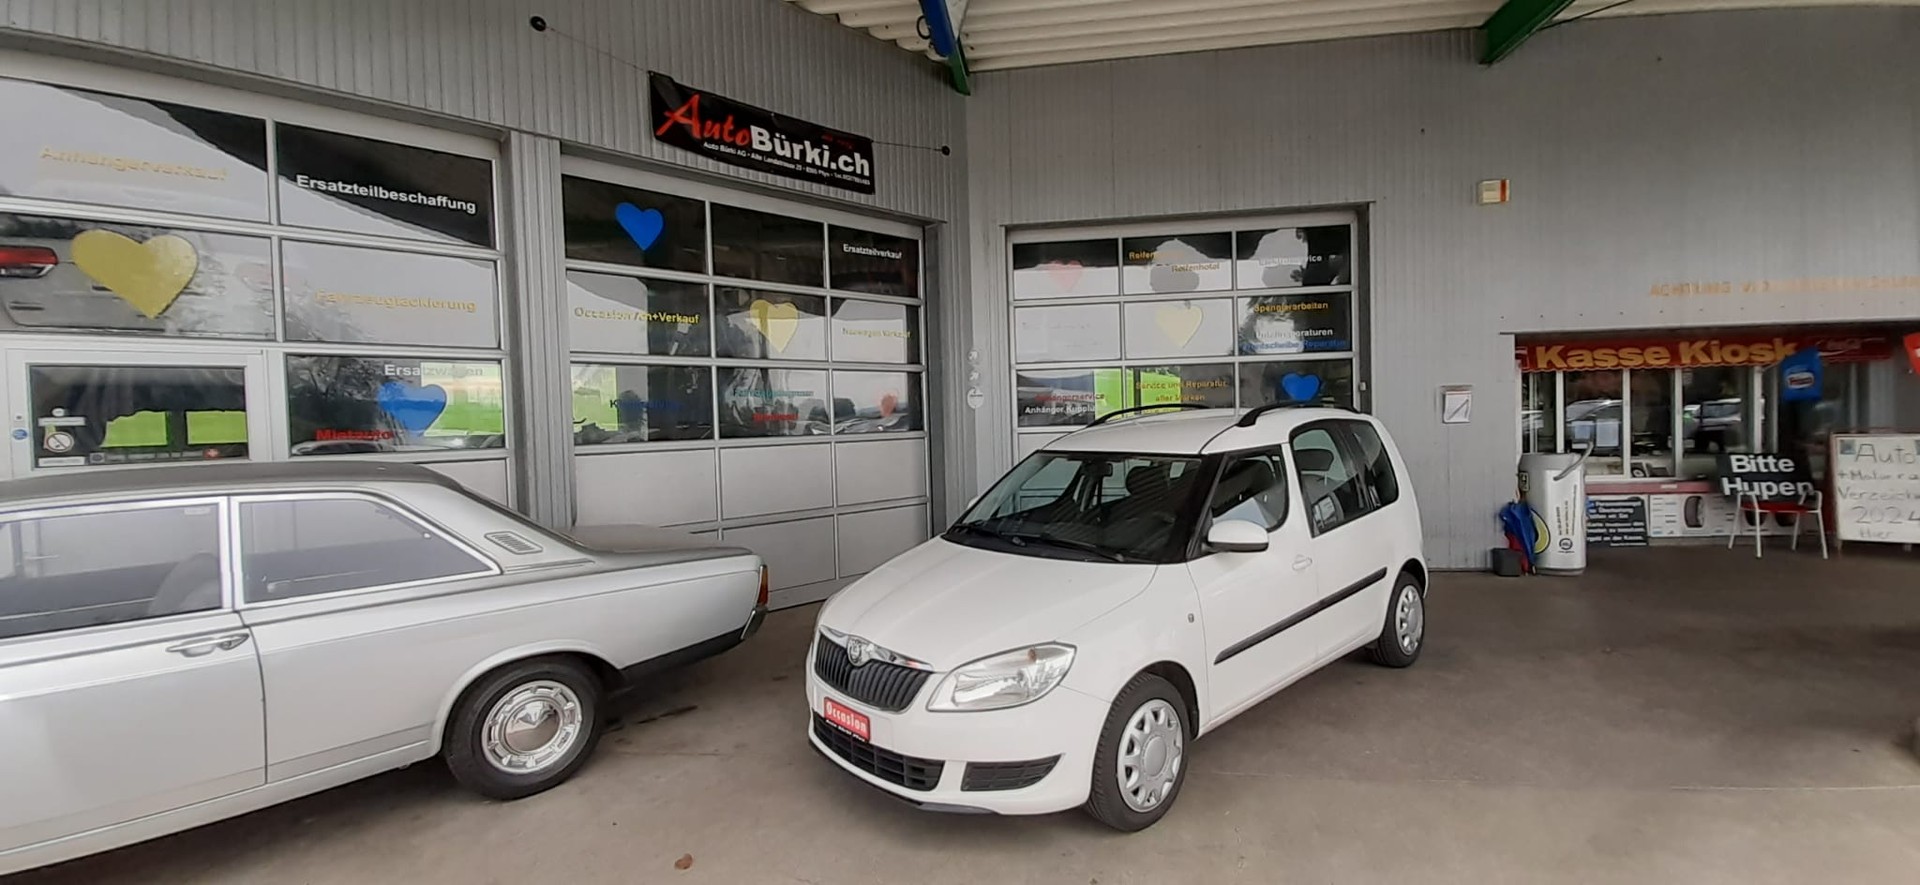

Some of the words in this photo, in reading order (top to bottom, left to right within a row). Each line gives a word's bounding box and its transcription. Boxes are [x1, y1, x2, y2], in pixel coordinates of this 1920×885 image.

[295, 173, 477, 215] Ersatzteilbeschaffung
[842, 243, 903, 260] Ersatzteilverkauf
[1535, 344, 1671, 369] Kasse
[1680, 338, 1797, 366] Kiosk
[1729, 454, 1796, 473] Bitte
[1855, 443, 1915, 464] Auto
[1721, 476, 1815, 501] Hupen
[827, 701, 867, 732] Occasion
